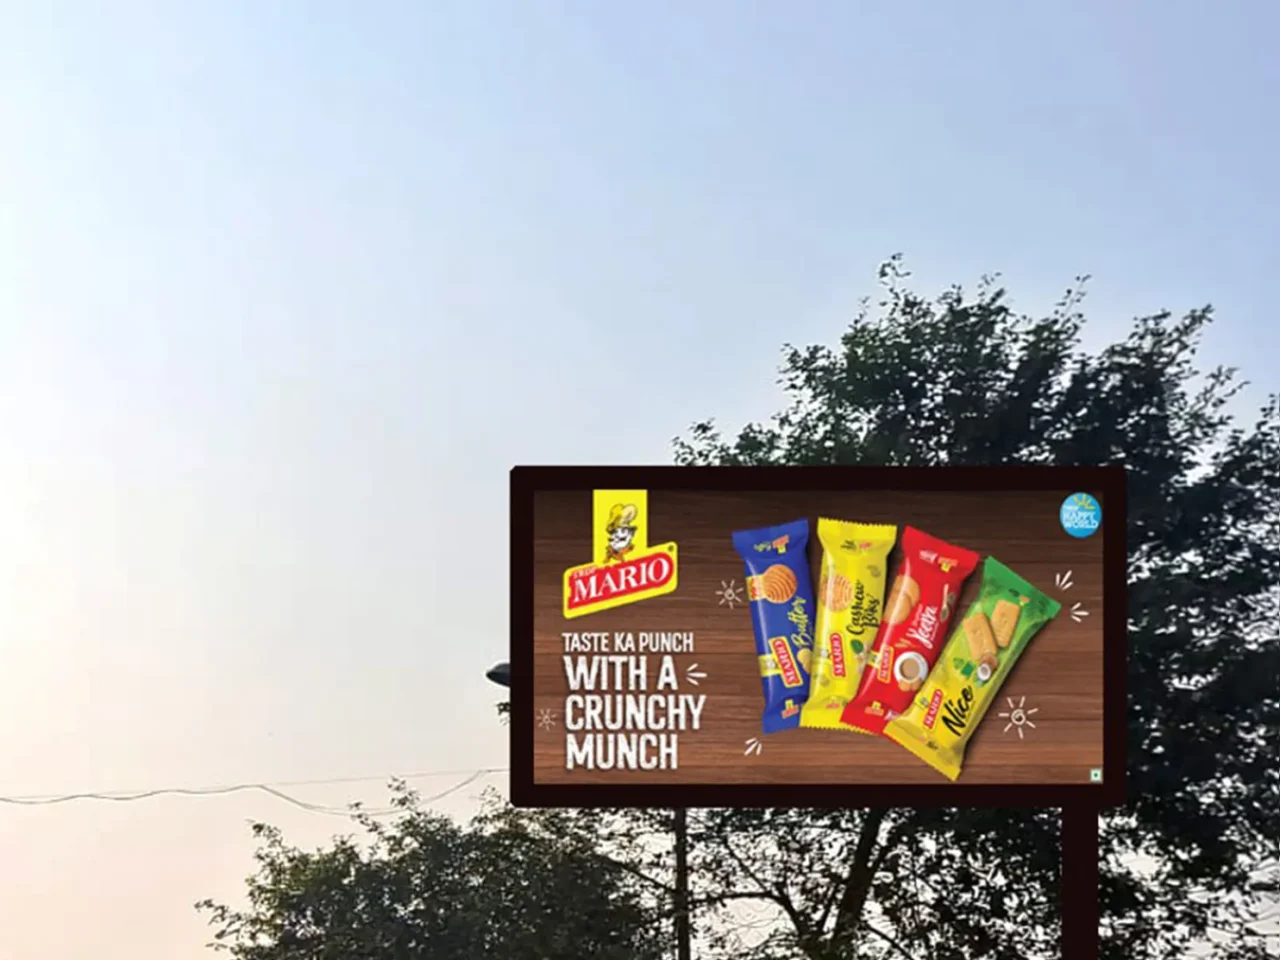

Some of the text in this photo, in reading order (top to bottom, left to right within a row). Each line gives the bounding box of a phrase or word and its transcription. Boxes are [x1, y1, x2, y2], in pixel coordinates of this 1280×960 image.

[572, 557, 670, 603] MARIO
[562, 632, 694, 652] TASTE KA PUNCH
[563, 655, 679, 690] WITH A
[565, 694, 707, 731] CRUNCHY
[941, 685, 974, 737] Nice
[566, 733, 678, 770] MUNCH
